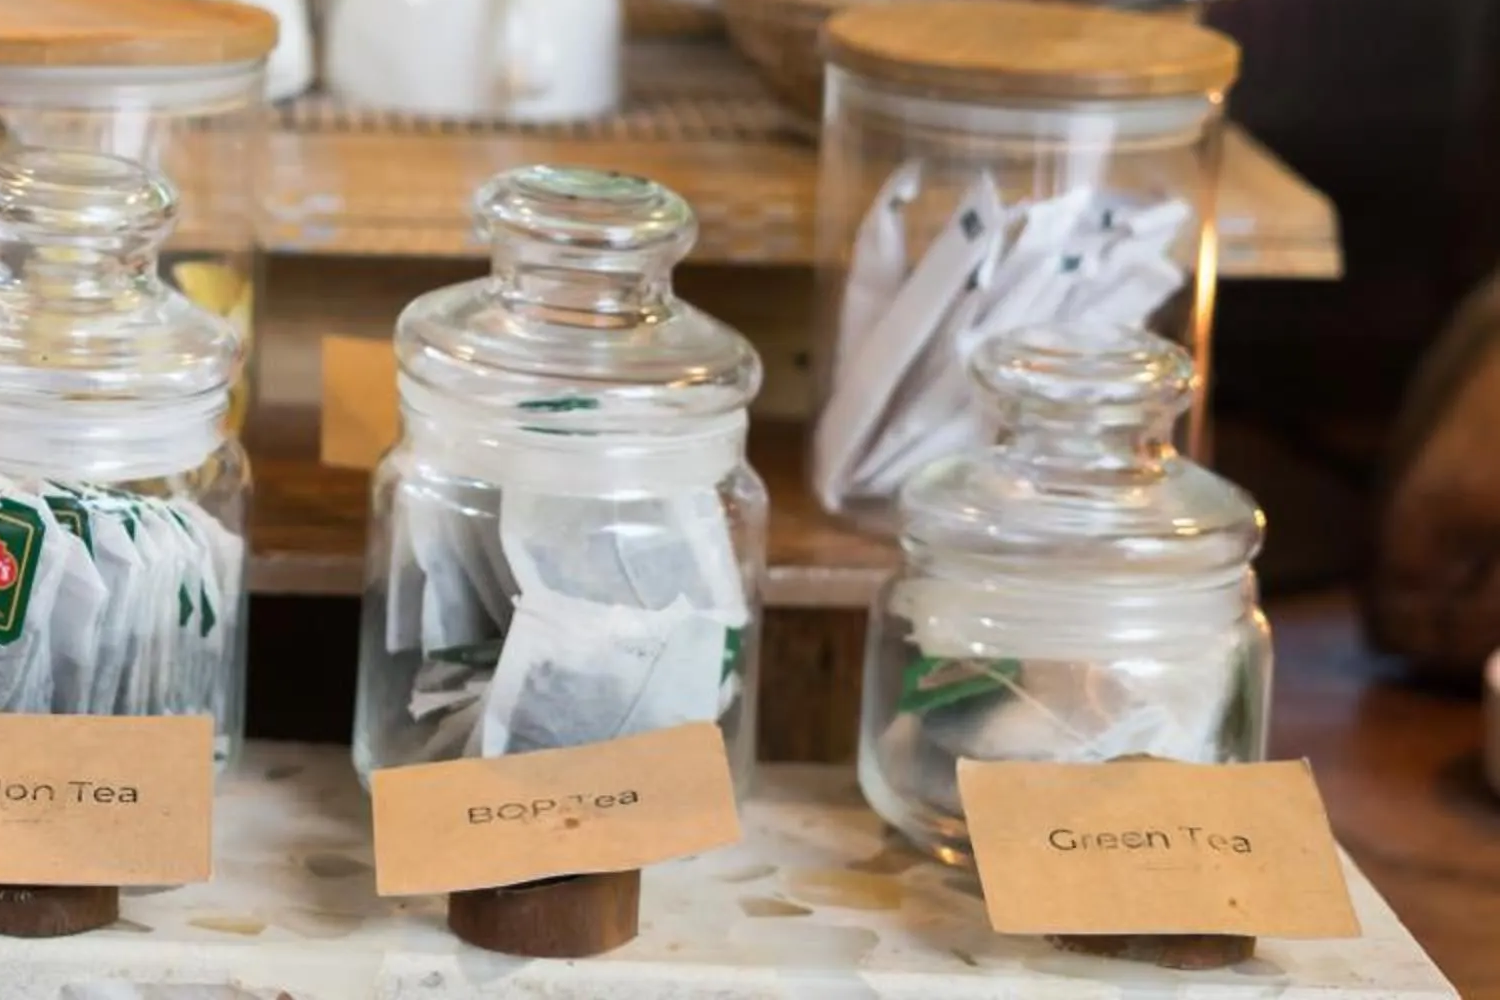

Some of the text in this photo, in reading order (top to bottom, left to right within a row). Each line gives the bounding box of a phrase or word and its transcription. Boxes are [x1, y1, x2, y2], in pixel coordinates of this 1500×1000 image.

[68, 780, 140, 804] Tea
[568, 789, 639, 811] Tea
[1049, 826, 1253, 853] Green Tea
